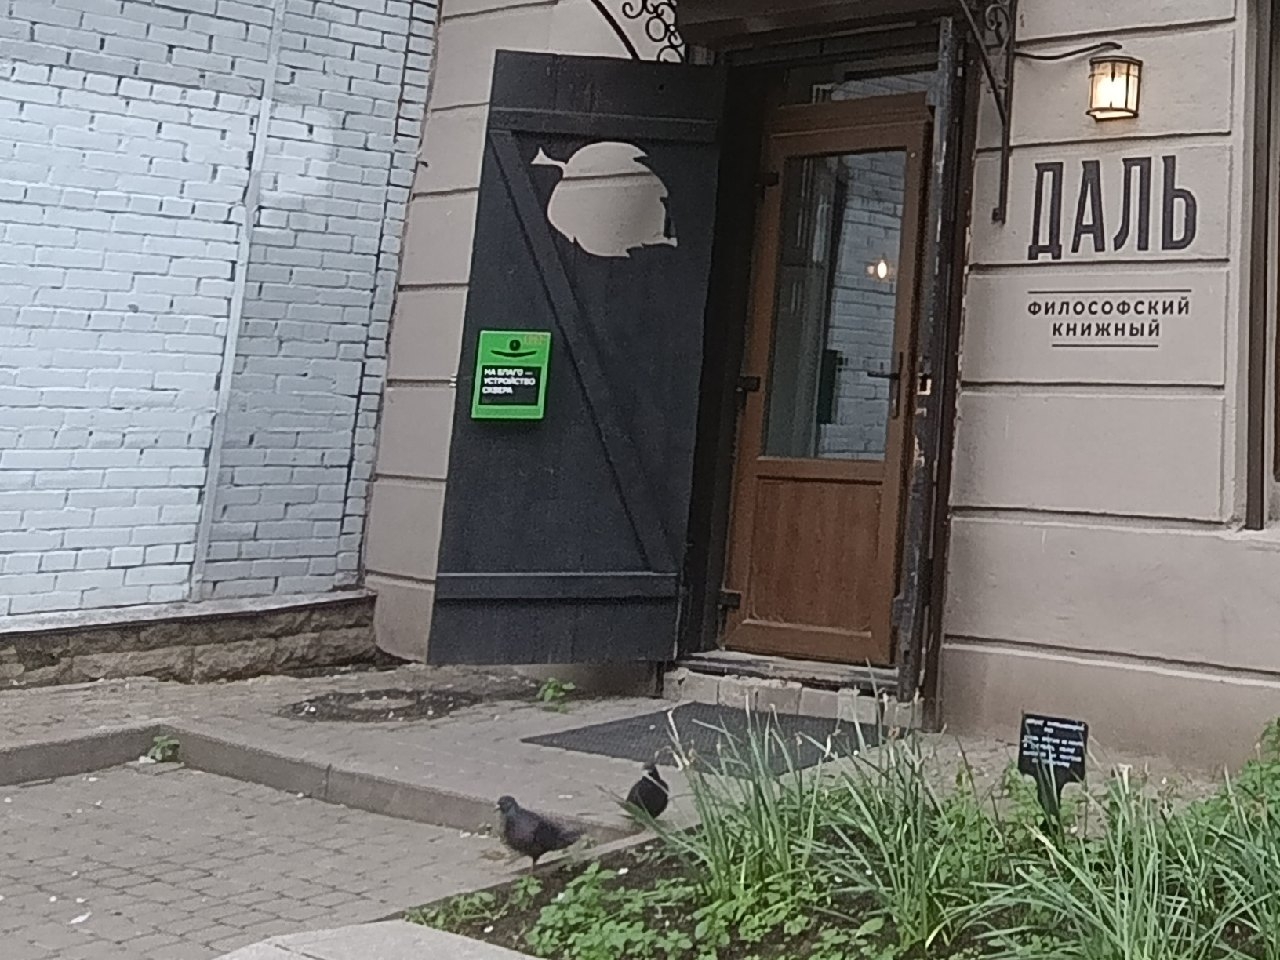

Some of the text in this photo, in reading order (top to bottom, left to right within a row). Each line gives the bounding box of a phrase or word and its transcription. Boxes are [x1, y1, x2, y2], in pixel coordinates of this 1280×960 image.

[1028, 155, 1197, 260] ДАЛЬ
[1027, 296, 1189, 315] ФИЛОСОФСКИЙ
[1052, 319, 1160, 337] КНИЖНЫЙ
